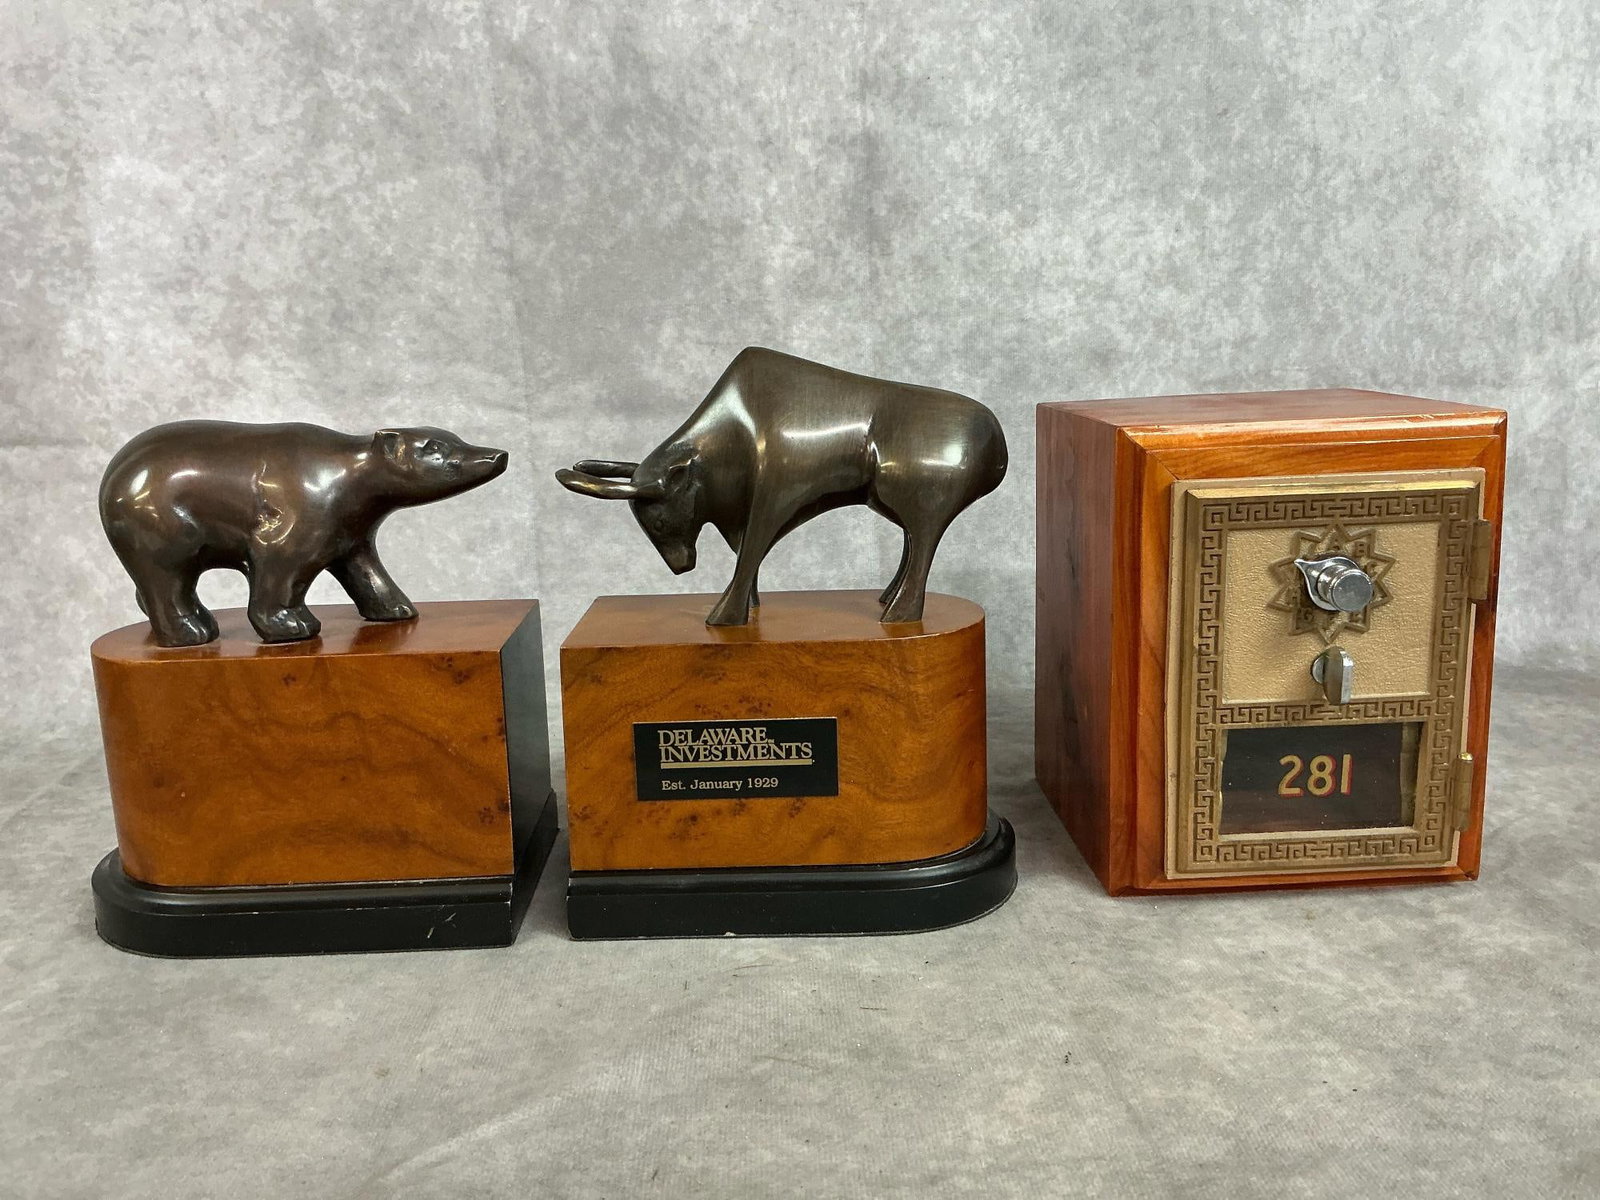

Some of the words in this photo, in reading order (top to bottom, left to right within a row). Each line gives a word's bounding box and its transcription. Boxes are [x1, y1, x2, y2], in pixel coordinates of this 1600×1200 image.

[658, 727, 768, 747] DELAWARE
[658, 742, 813, 763] INVESTMENTS
[661, 780, 686, 791] Est.
[690, 778, 743, 792] January
[747, 777, 779, 788] 1929
[1278, 753, 1353, 797] 281
